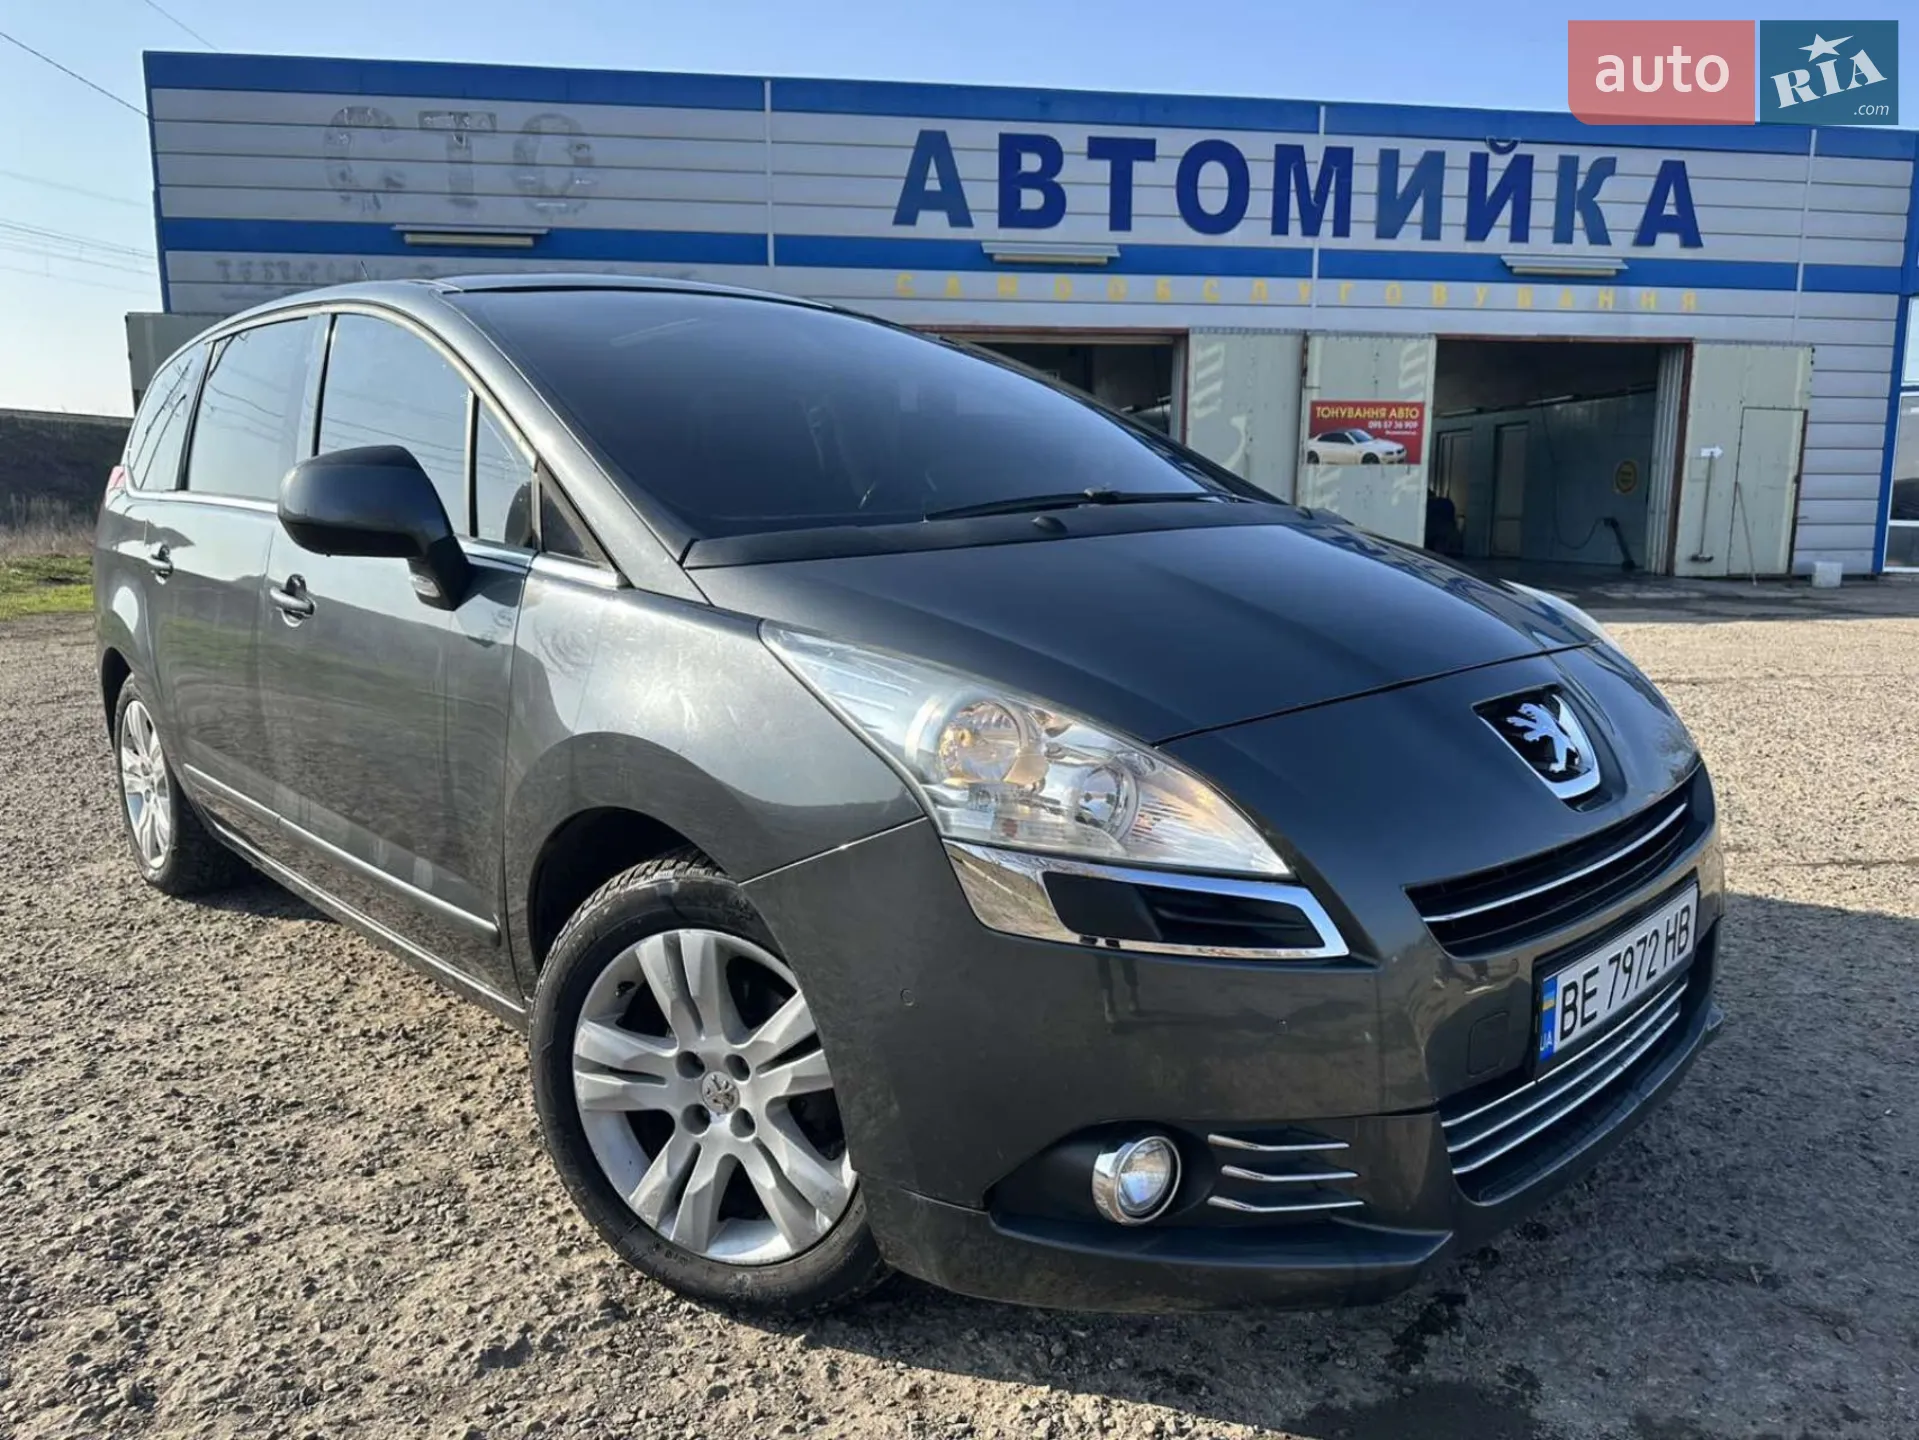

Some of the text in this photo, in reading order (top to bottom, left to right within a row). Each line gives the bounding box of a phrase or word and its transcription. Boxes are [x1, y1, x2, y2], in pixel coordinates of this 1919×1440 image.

[892, 129, 1704, 249] АВТОМИЙКА
[1315, 406, 1420, 420] ТОНУВАННЯ АВТО
[1559, 904, 1692, 1041] BE 7972 HB
